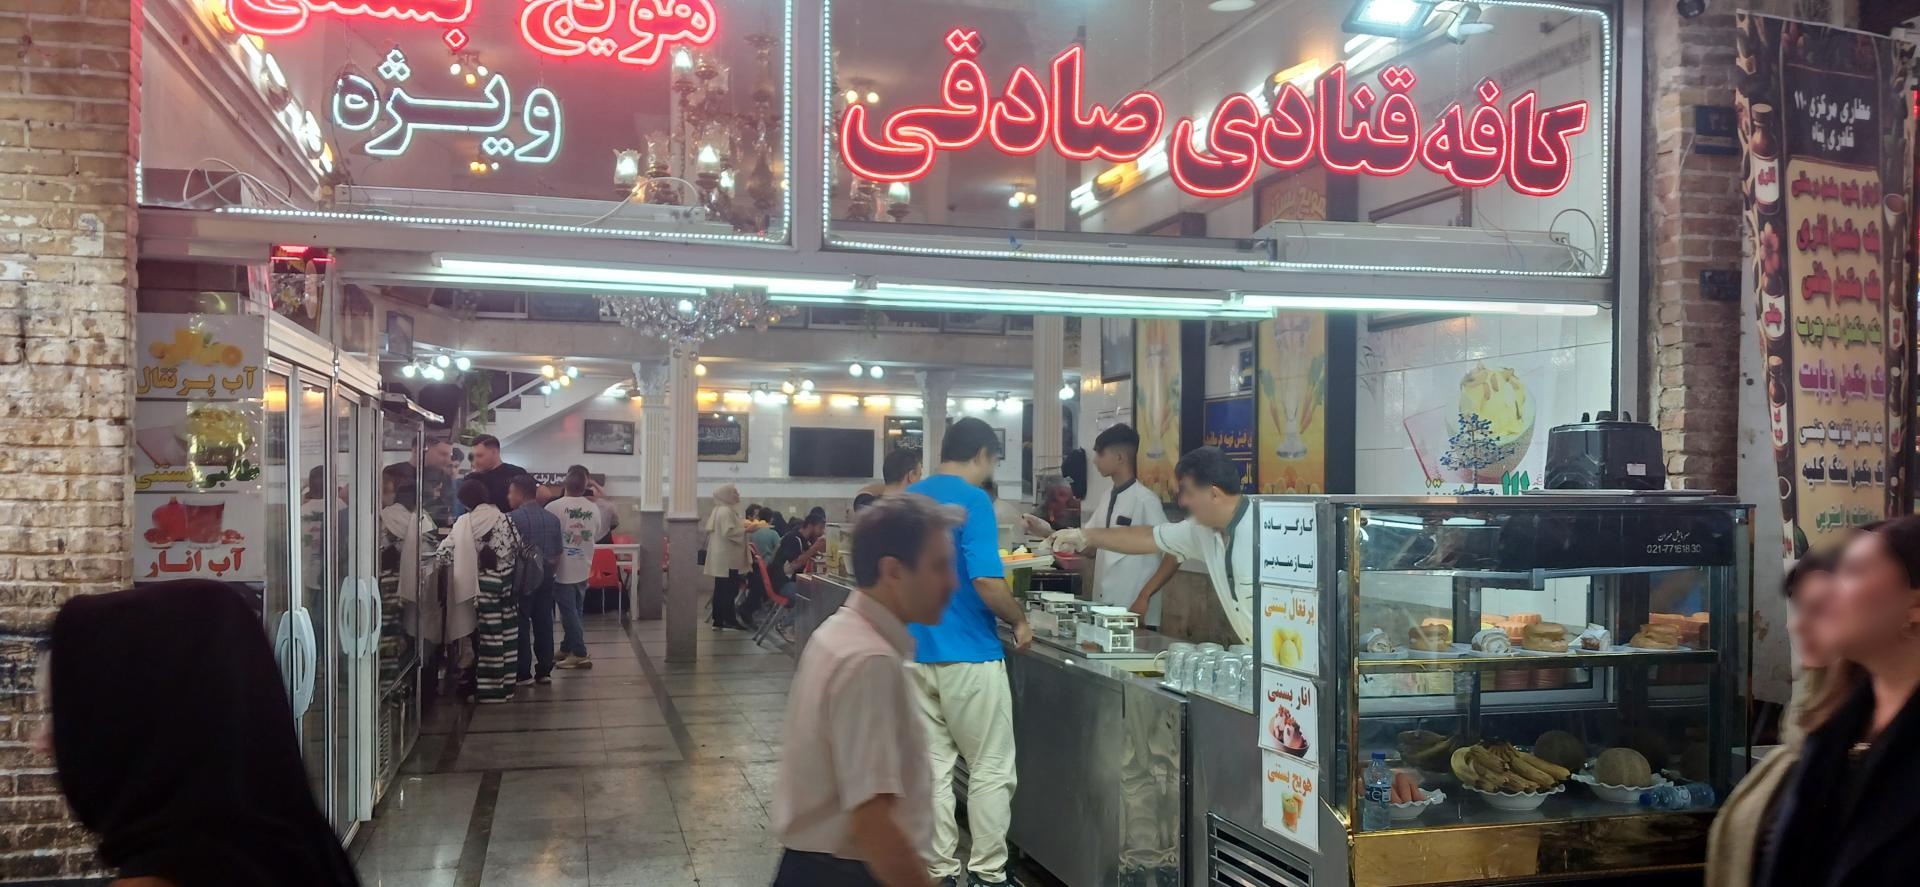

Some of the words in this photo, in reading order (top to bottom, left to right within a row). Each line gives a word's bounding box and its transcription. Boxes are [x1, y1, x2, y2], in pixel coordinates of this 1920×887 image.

[333, 46, 566, 164] ویژه
[840, 27, 1166, 183] صادقی
[1171, 63, 1420, 199] قنادی
[1417, 76, 1590, 197] کافه
[136, 366, 217, 396] پرتقال
[221, 366, 258, 394] آب
[1799, 359, 1836, 404] دیابت
[135, 463, 193, 489] بستنی
[1802, 456, 1825, 491] کلیه
[1263, 517, 1281, 530] ساده
[1284, 518, 1313, 535] کارگر
[144, 550, 202, 578] انار
[208, 547, 246, 577] آب
[1264, 554, 1314, 573] نیازمندیم
[1264, 597, 1287, 618] بستنی
[1268, 682, 1293, 707] بستنی
[1295, 685, 1311, 710] انار
[1267, 763, 1290, 788] بستنی
[1292, 773, 1312, 797] هویج
